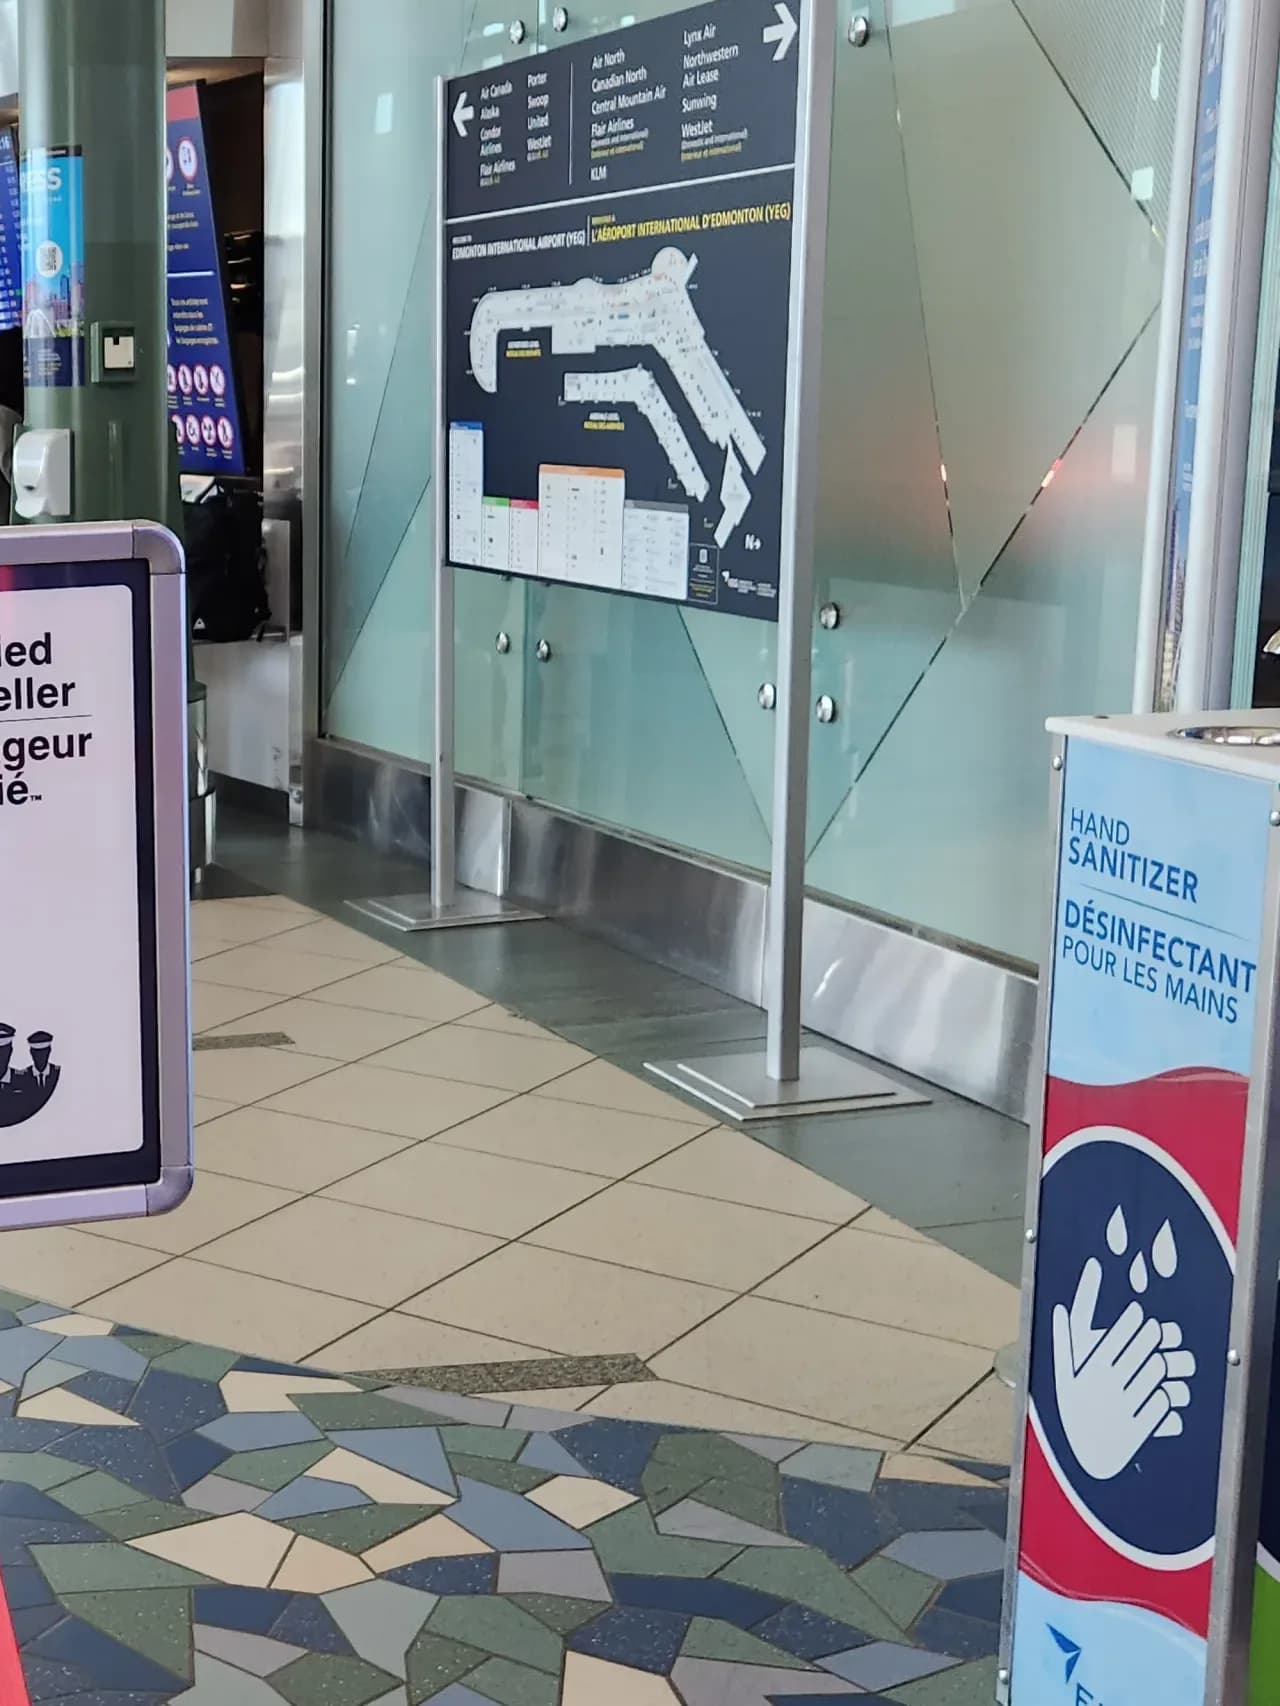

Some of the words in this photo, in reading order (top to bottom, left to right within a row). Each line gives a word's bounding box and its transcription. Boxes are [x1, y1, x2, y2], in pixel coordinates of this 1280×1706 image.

[683, 28, 703, 48] Lynx
[703, 23, 717, 40] Air
[591, 53, 604, 70] Air
[604, 48, 625, 66] North
[683, 43, 739, 70] Northwestern
[528, 72, 548, 88] Porter
[591, 72, 625, 93] Canadian
[625, 65, 647, 84] North
[682, 72, 695, 88] Air
[696, 67, 719, 86] Lease
[480, 86, 490, 100] Air
[490, 80, 513, 97] Canada
[591, 95, 617, 115] Central
[618, 87, 653, 109] Mountain
[654, 84, 667, 101] Air
[480, 104, 500, 120] Alaska
[528, 94, 549, 110] Swoop
[682, 92, 717, 113] Sunwing
[528, 112, 549, 130] United
[591, 121, 607, 138] Flair
[607, 116, 635, 134] Airlines
[681, 119, 713, 138] WestJet
[480, 125, 502, 141] Condor
[527, 134, 552, 151] WestJet
[480, 141, 502, 157] Airlines
[480, 162, 492, 177] Flair
[493, 158, 516, 175] Airlines
[590, 164, 608, 182] KLM
[591, 222, 636, 244] L'AÉROPORT
[637, 214, 701, 238] INTERNATIONAL
[701, 203, 767, 230] D'EDMONTON
[765, 200, 791, 223] (YEG)
[452, 243, 487, 260] EDMONTON
[487, 236, 538, 257] INTERNATIONAL
[537, 231, 566, 250] AIRPORT
[566, 228, 586, 248] (YEG)
[1070, 807, 1130, 846] HAND
[1068, 836, 1198, 904] SANITIZER
[1064, 899, 1257, 993] DÉSINFECTANT
[1062, 935, 1117, 977] POUR
[1123, 957, 1158, 993] LES
[1165, 973, 1239, 1024] MAINS
